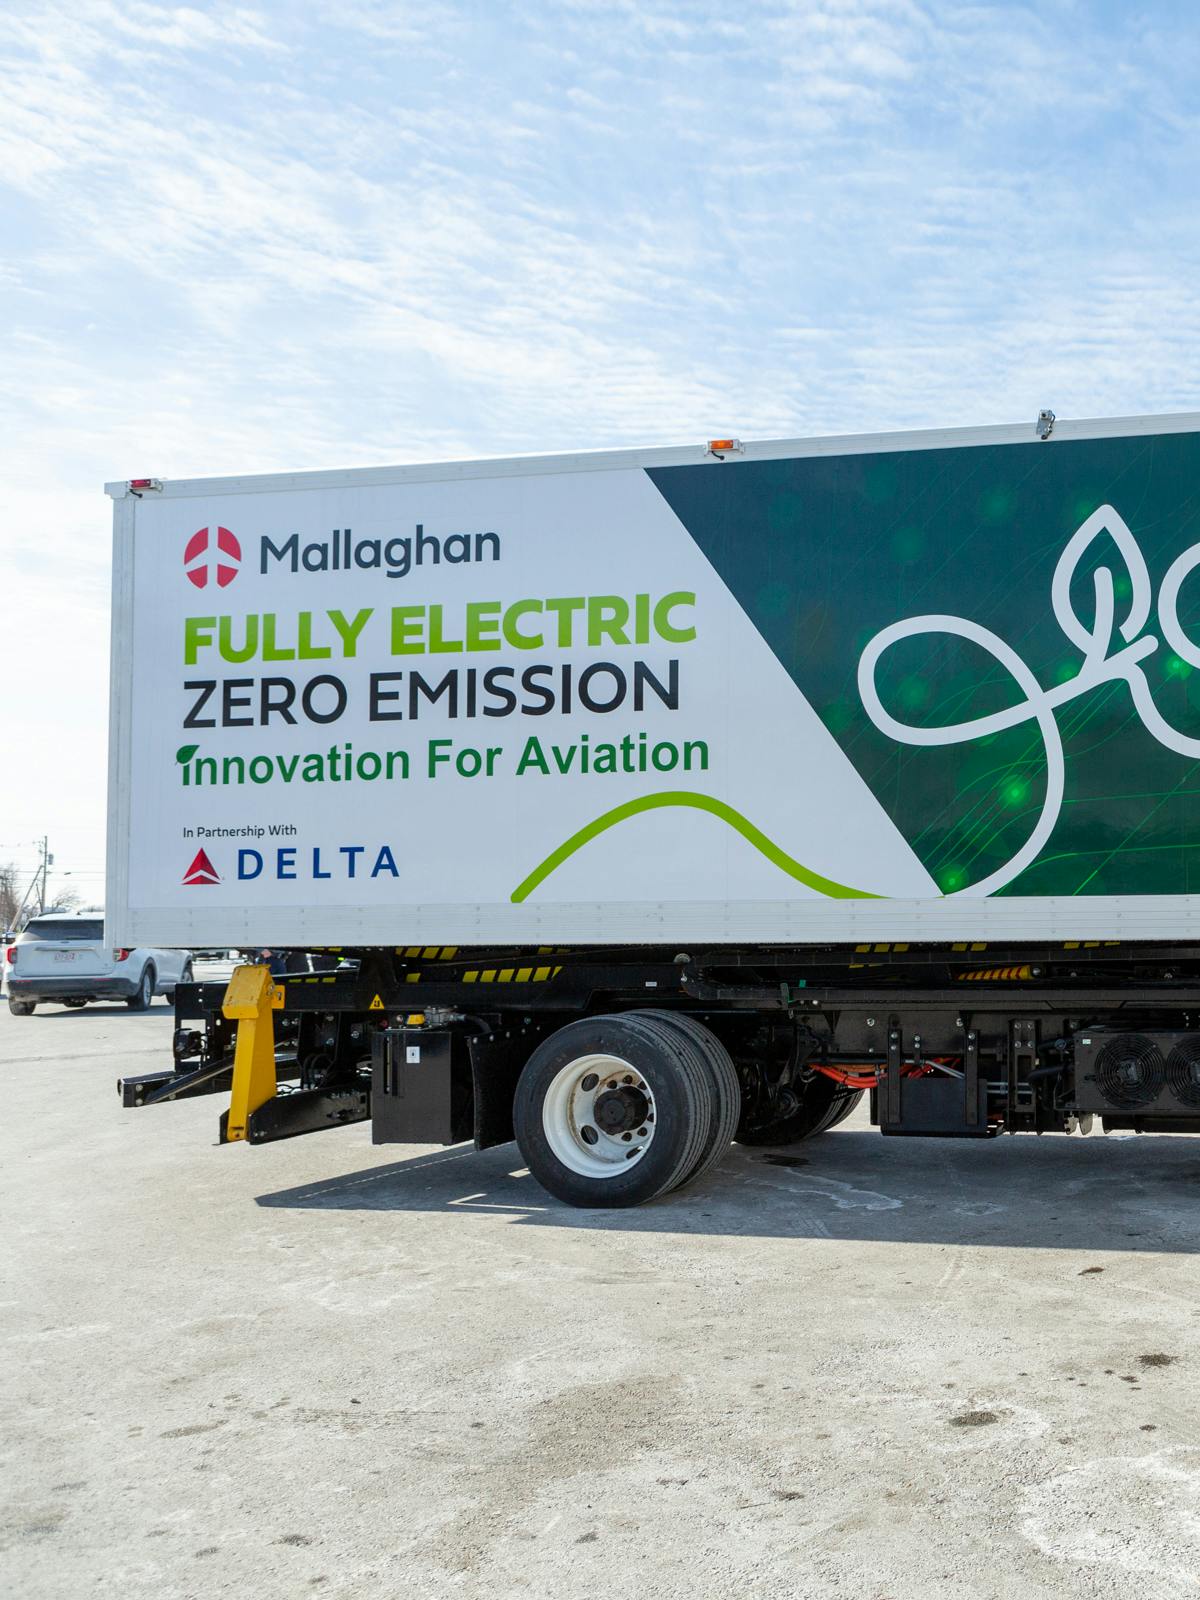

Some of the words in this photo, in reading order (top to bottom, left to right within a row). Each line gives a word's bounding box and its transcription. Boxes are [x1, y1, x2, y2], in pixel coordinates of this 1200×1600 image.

[260, 524, 501, 578] Mallaghan
[184, 608, 374, 665] FULLY
[391, 591, 697, 655] ELECTRIC
[183, 674, 347, 729] ZERO
[369, 659, 680, 722] EMISSION
[428, 739, 504, 778] For
[515, 732, 709, 775] Aviation
[183, 827, 194, 838] In
[197, 825, 265, 839] Partnership
[268, 824, 298, 836] With
[238, 845, 400, 880] DELTA
